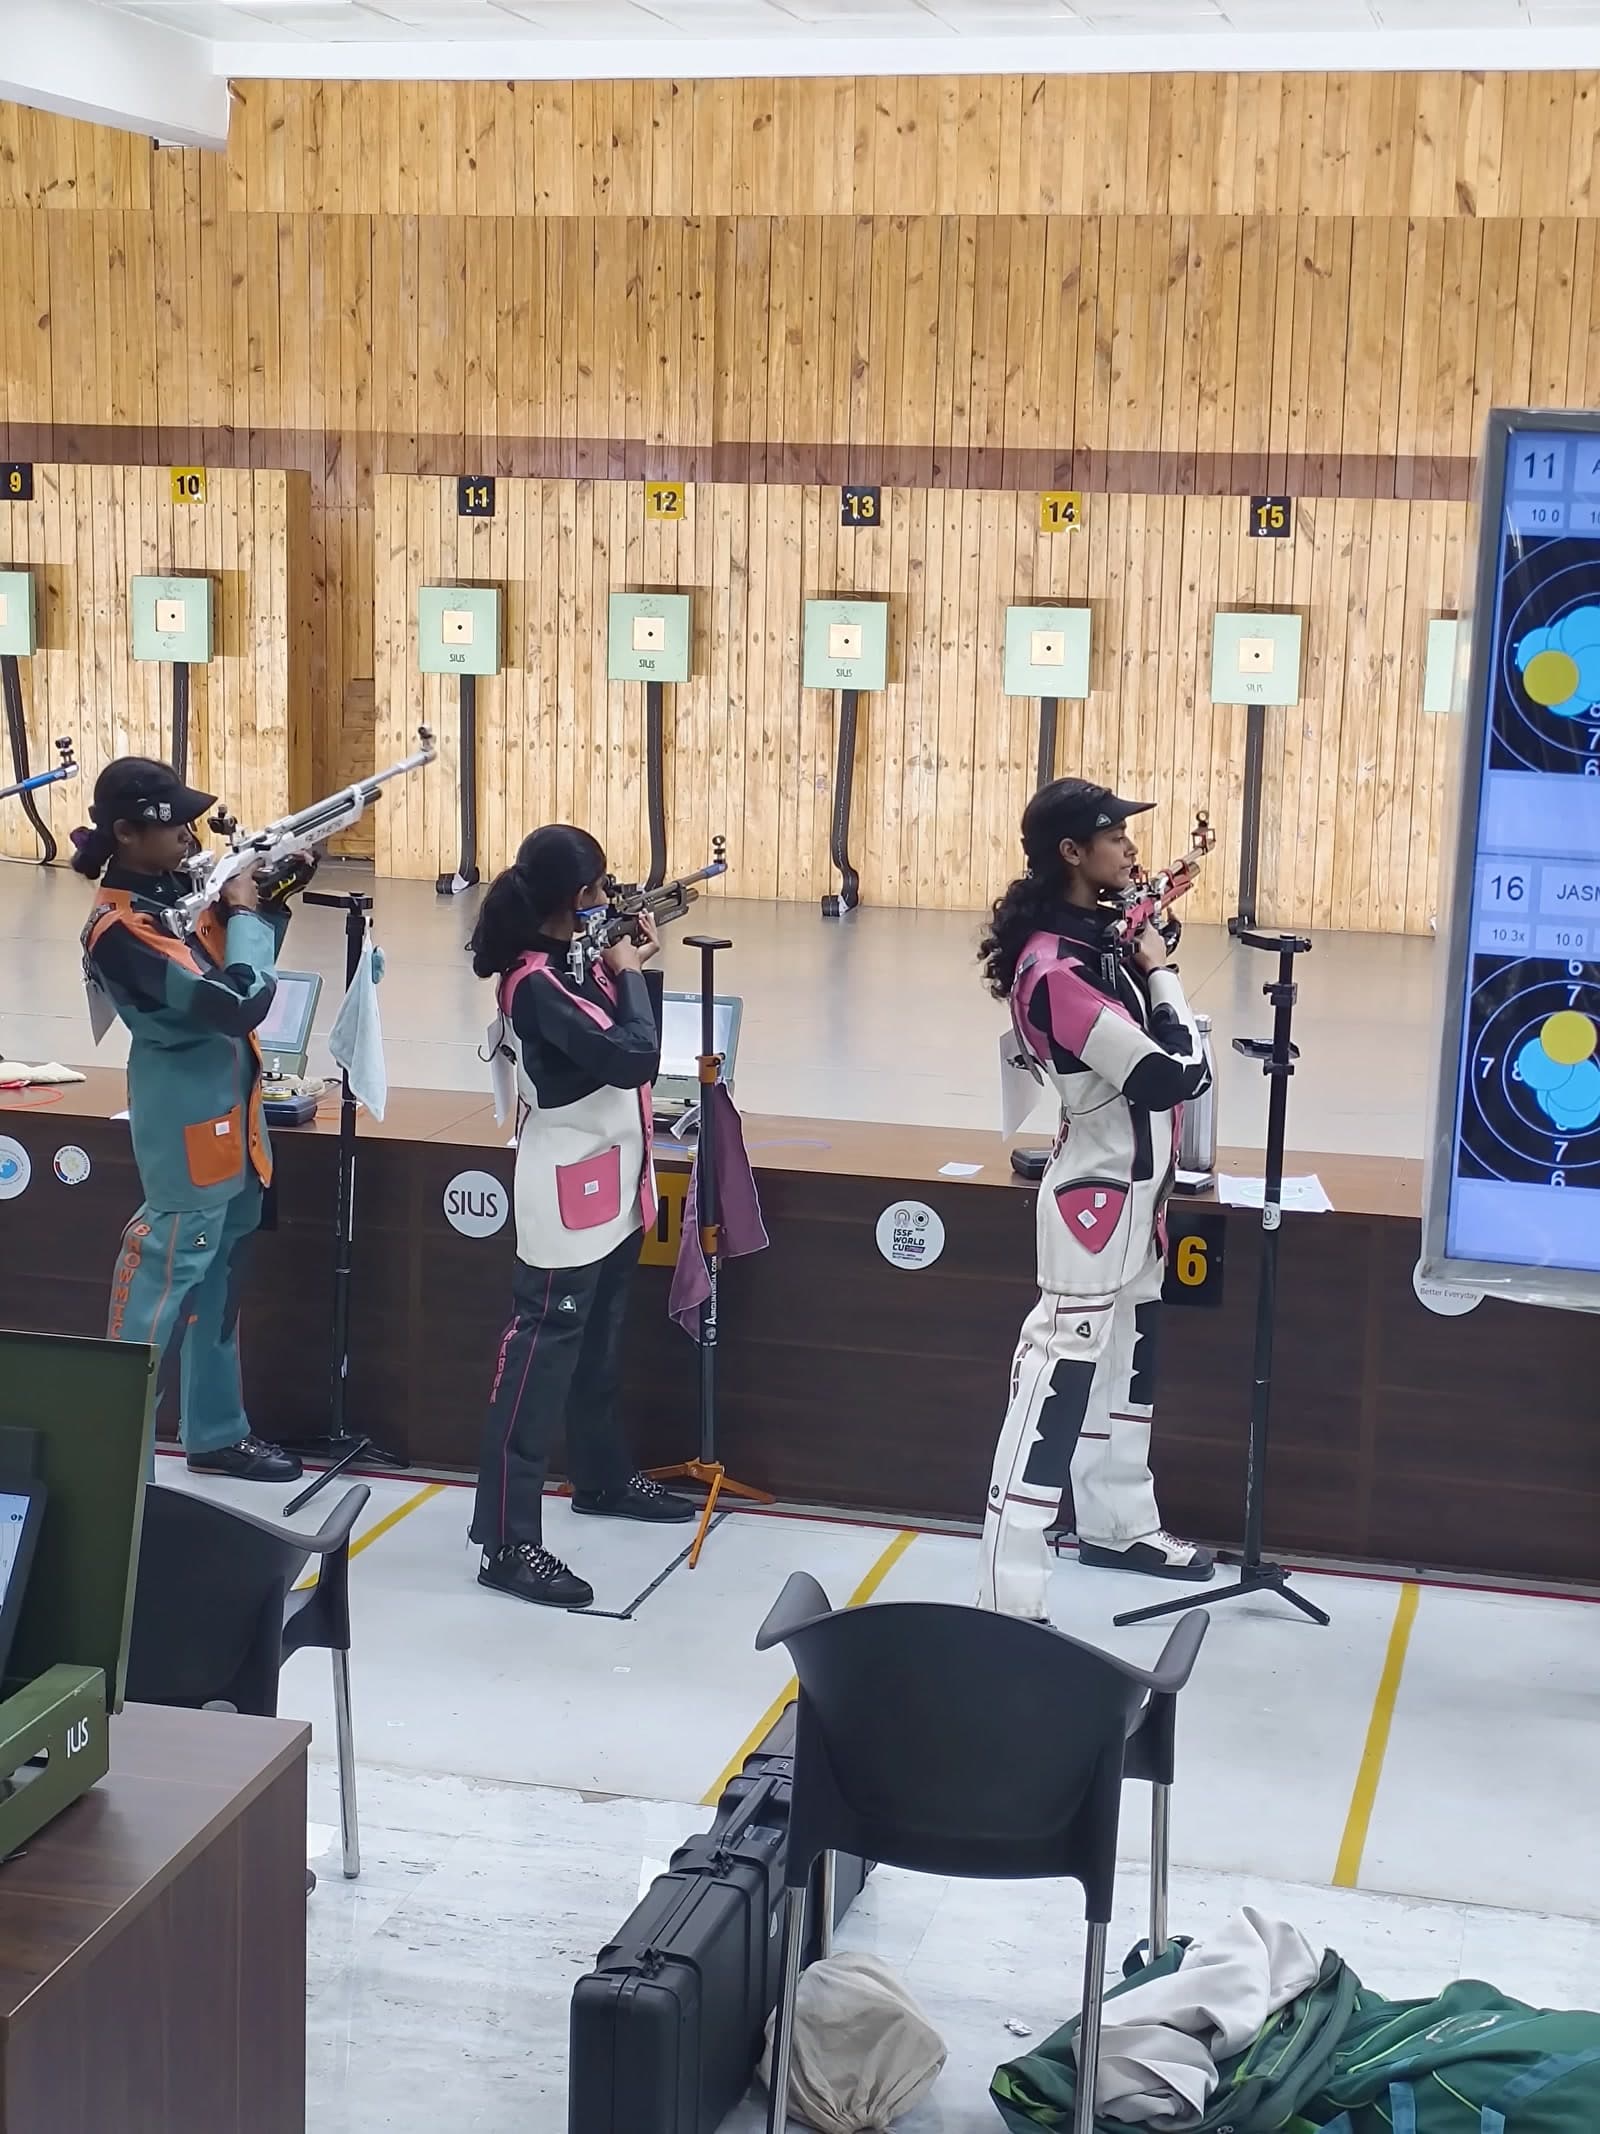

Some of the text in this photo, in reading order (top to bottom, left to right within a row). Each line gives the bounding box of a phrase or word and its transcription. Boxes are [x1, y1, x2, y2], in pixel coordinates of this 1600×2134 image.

[1524, 452, 1555, 479] 11
[9, 471, 22, 494] 9
[176, 474, 201, 498] 10
[465, 485, 489, 509] 11
[652, 490, 678, 513] 12
[849, 494, 875, 518] 13
[1048, 500, 1077, 524] 14
[1256, 505, 1285, 529] 15
[449, 653, 466, 663] SIUS
[638, 658, 656, 670] SIUS
[835, 667, 853, 679] SIUS
[1491, 875, 1524, 901] 16
[1567, 985, 1582, 1007] 7
[1480, 1057, 1495, 1079] 7
[1554, 1141, 1568, 1162] 7
[447, 1189, 498, 1218] SIUS
[893, 1236, 926, 1246] WORLD
[894, 1228, 914, 1238] ISSF
